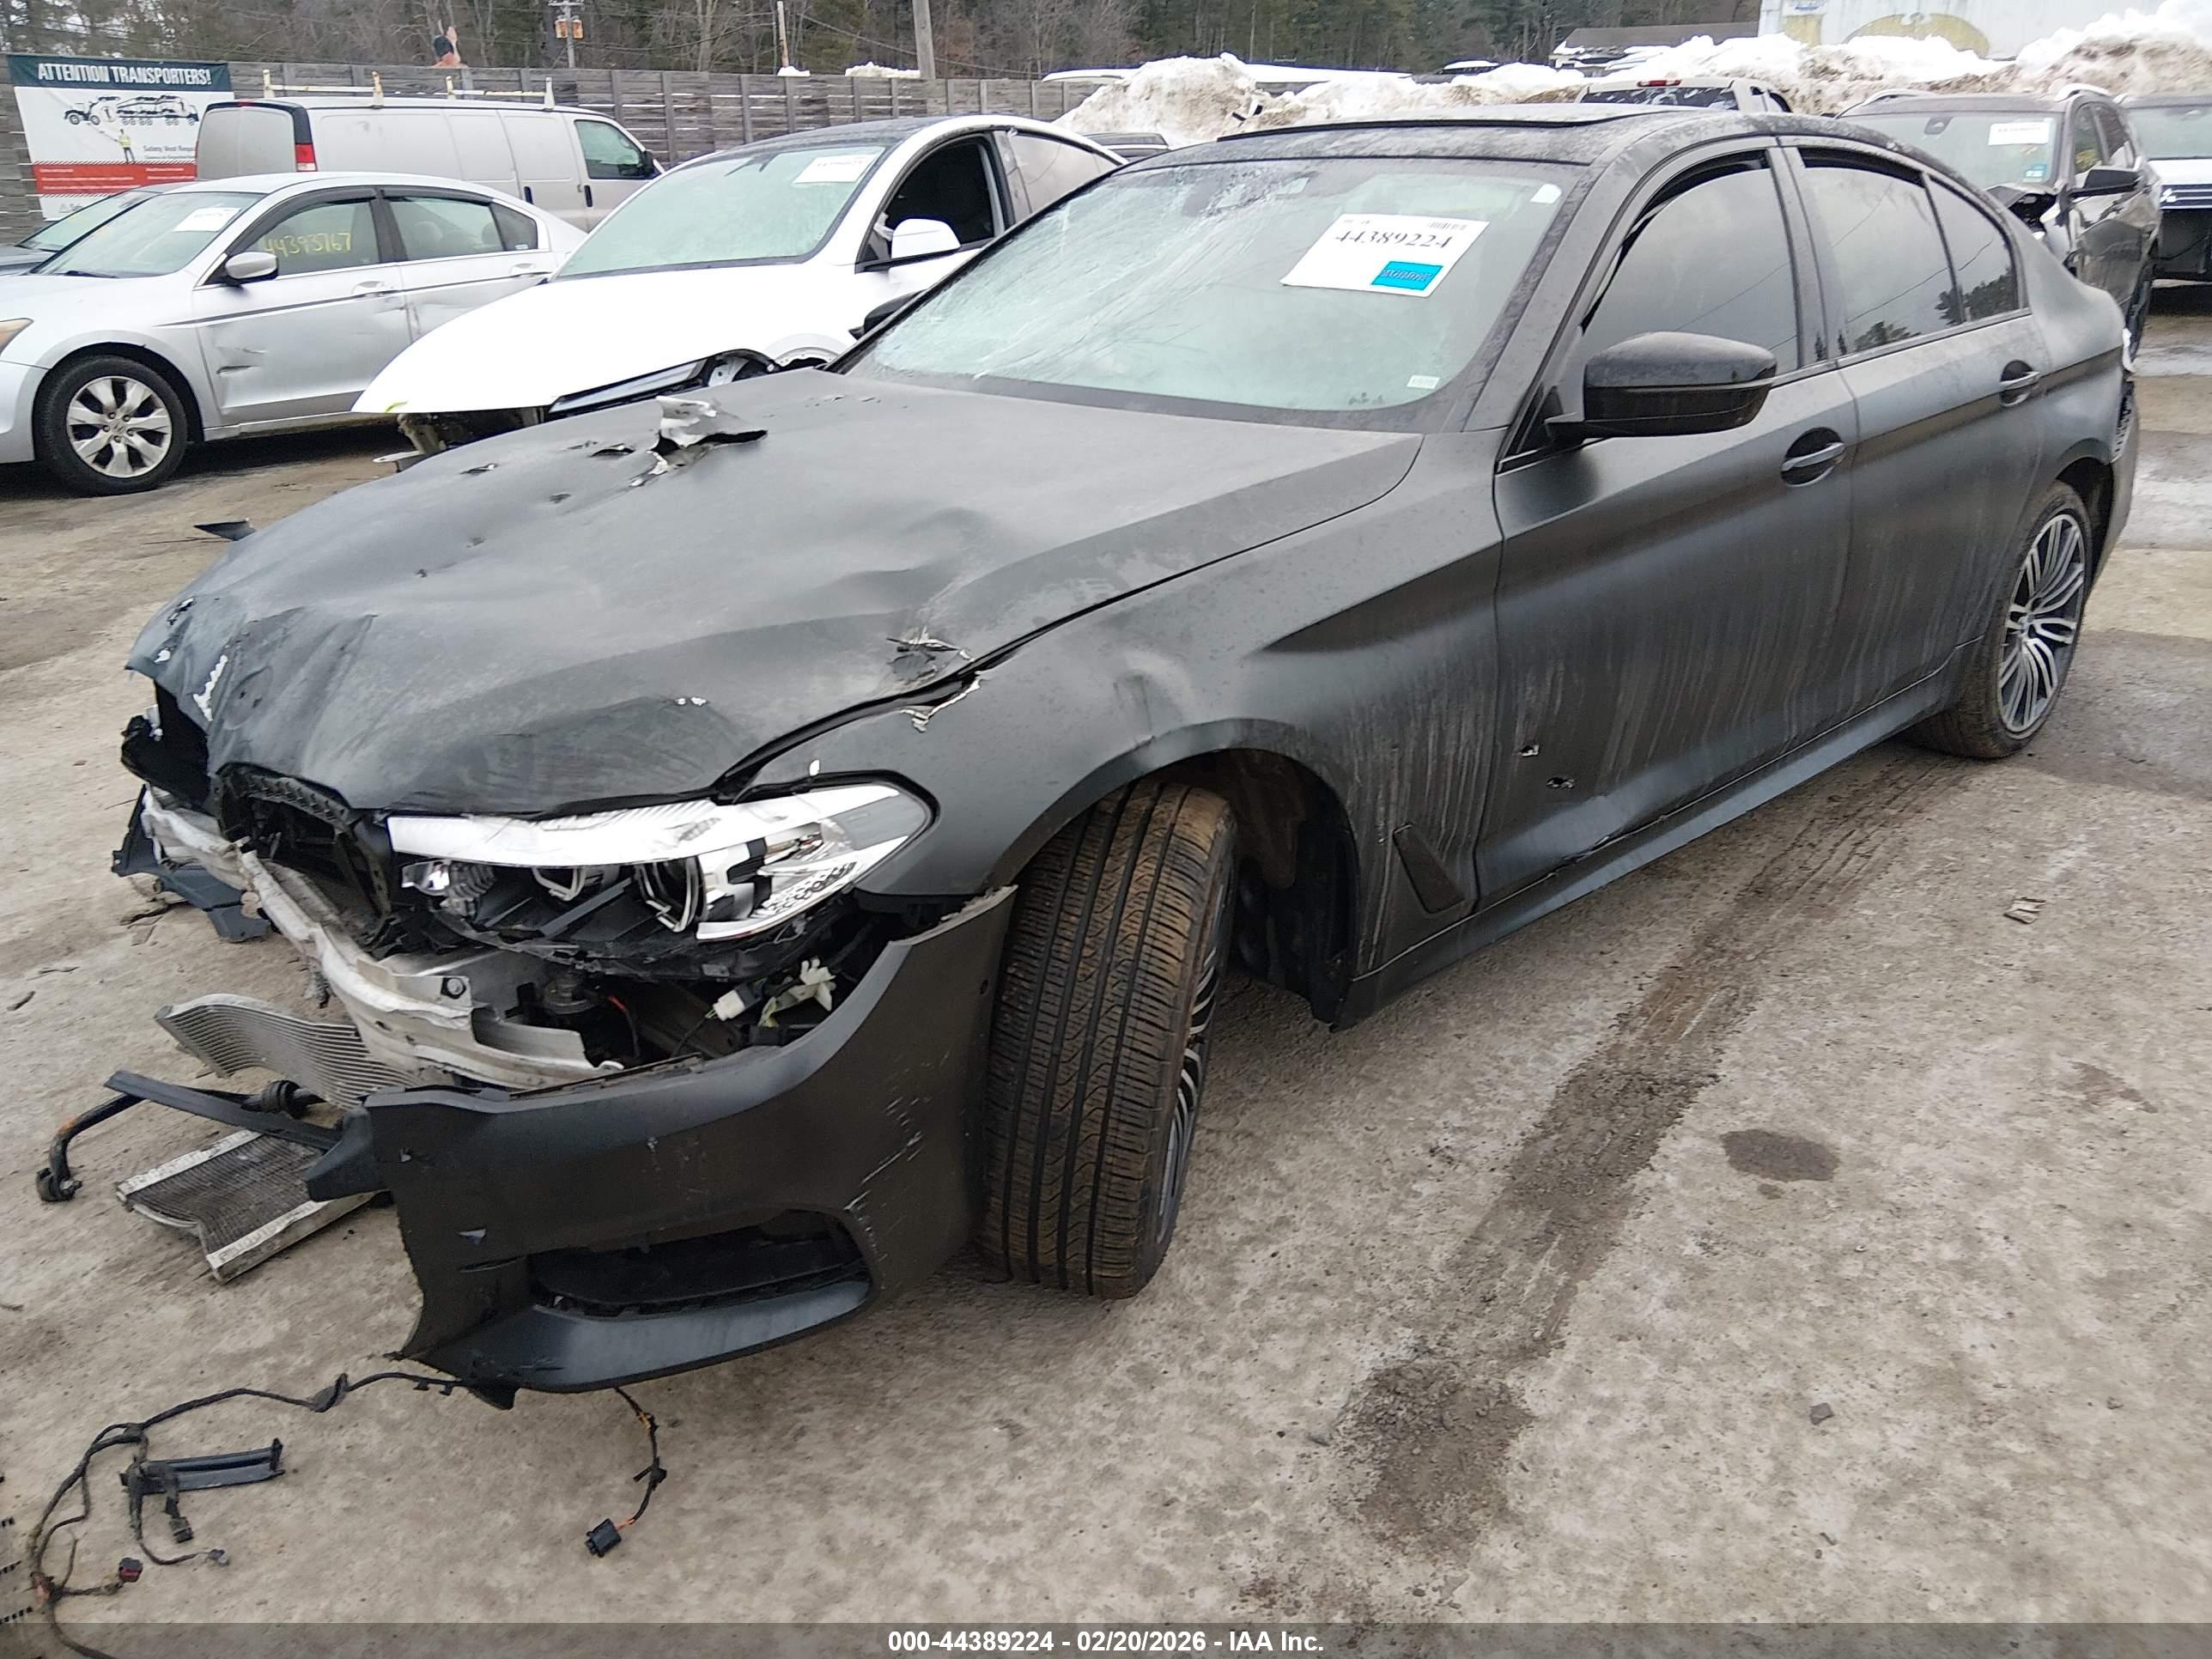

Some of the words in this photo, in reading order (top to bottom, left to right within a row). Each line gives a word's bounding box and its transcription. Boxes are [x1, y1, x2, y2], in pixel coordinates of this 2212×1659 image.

[38, 63, 110, 82] ATTENTION
[111, 66, 212, 85] TRANSPORTERS!
[1335, 230, 1453, 248] 44389224
